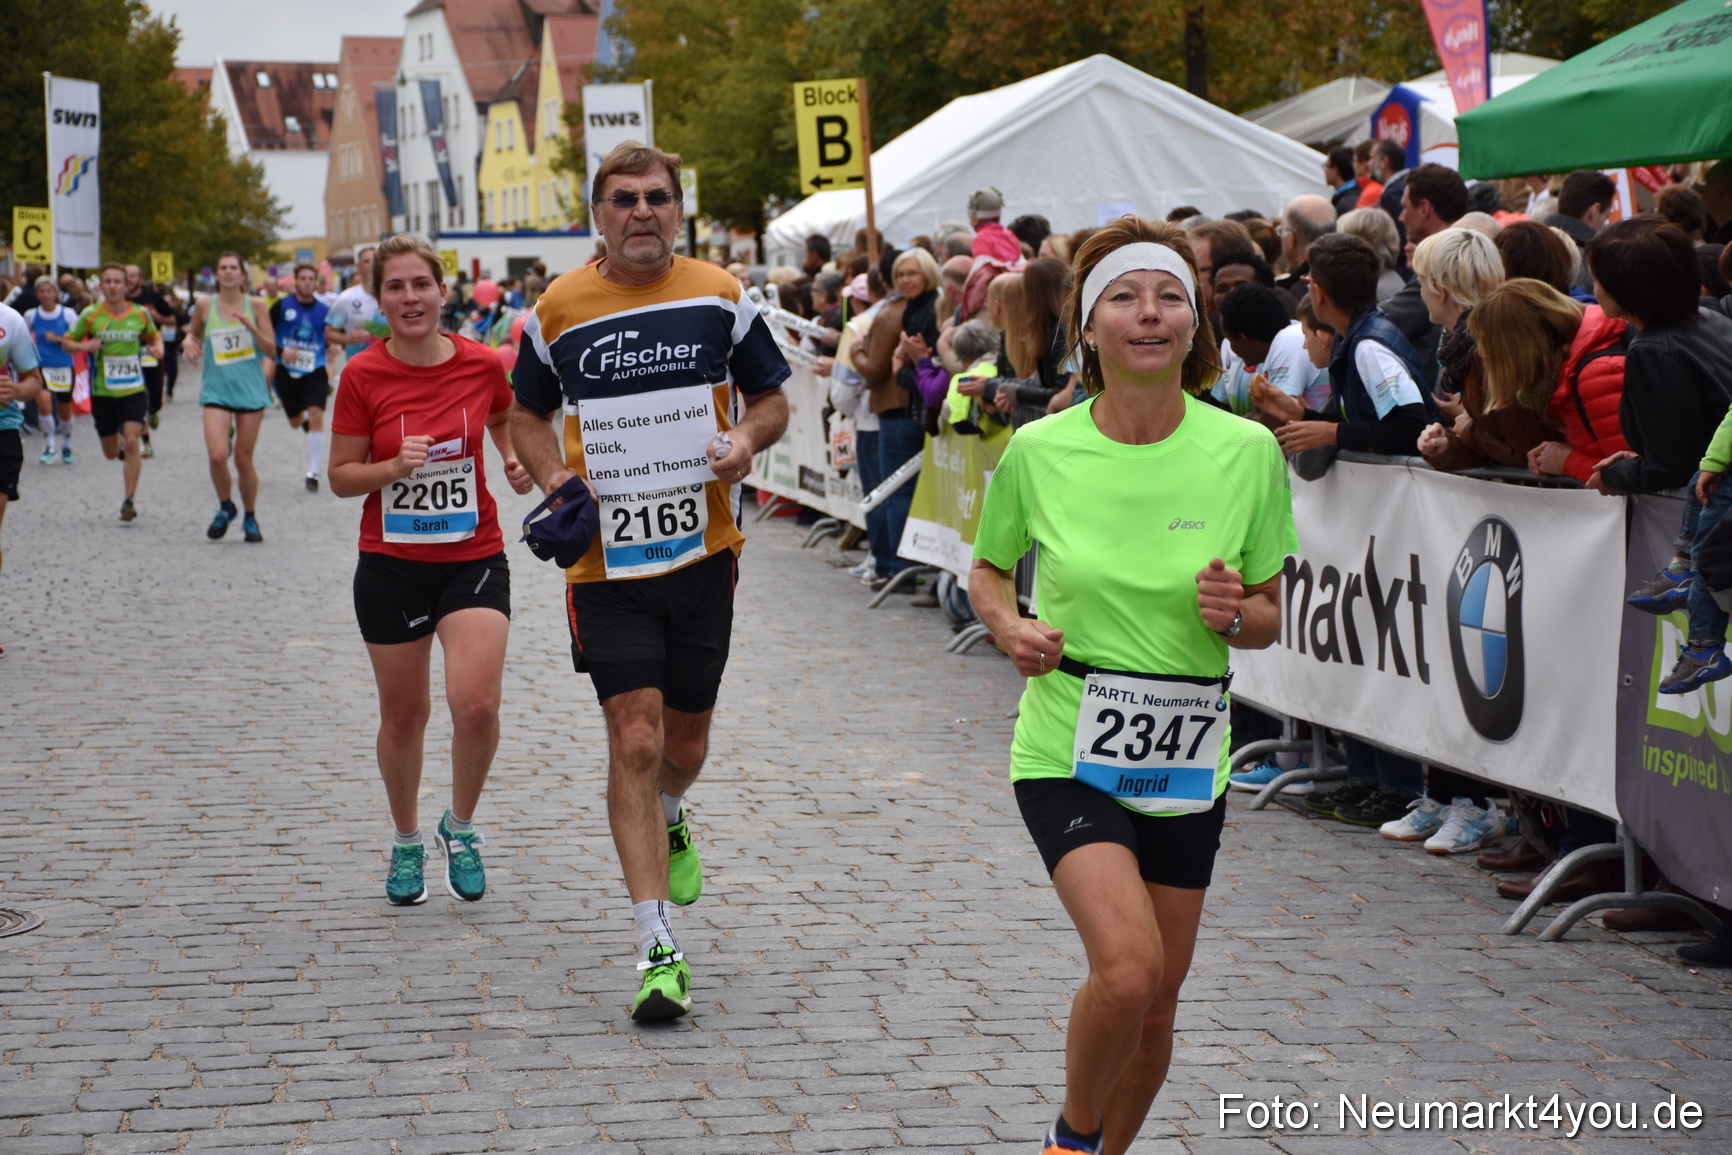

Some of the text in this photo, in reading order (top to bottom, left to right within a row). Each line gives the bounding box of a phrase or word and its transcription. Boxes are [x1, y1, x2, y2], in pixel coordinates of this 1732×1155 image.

[803, 84, 859, 107] Block
[53, 108, 97, 128] swn
[816, 114, 852, 168] B
[23, 225, 42, 251] C
[223, 335, 241, 349] 37
[600, 341, 702, 372] Fischer
[108, 362, 138, 376] 2734
[611, 361, 696, 381] AUTOMOBILE
[583, 404, 708, 432] Alles Gute und viel
[585, 441, 627, 455] Glück,
[416, 466, 458, 480] Neumarkt
[589, 456, 708, 480] Lena und Thomas
[392, 477, 468, 511] 2205
[601, 486, 687, 503] PARTL Neumarkt
[413, 519, 448, 532] Sarah
[612, 498, 699, 542] 2163
[1180, 520, 1206, 530] asics
[645, 546, 673, 560] Otto
[1455, 523, 1521, 599] BMW
[1087, 684, 1210, 709] PARTL Neumarkt
[1090, 708, 1217, 762] 2347
[1643, 735, 1717, 791] inspired
[1117, 774, 1169, 797] Ingrid
